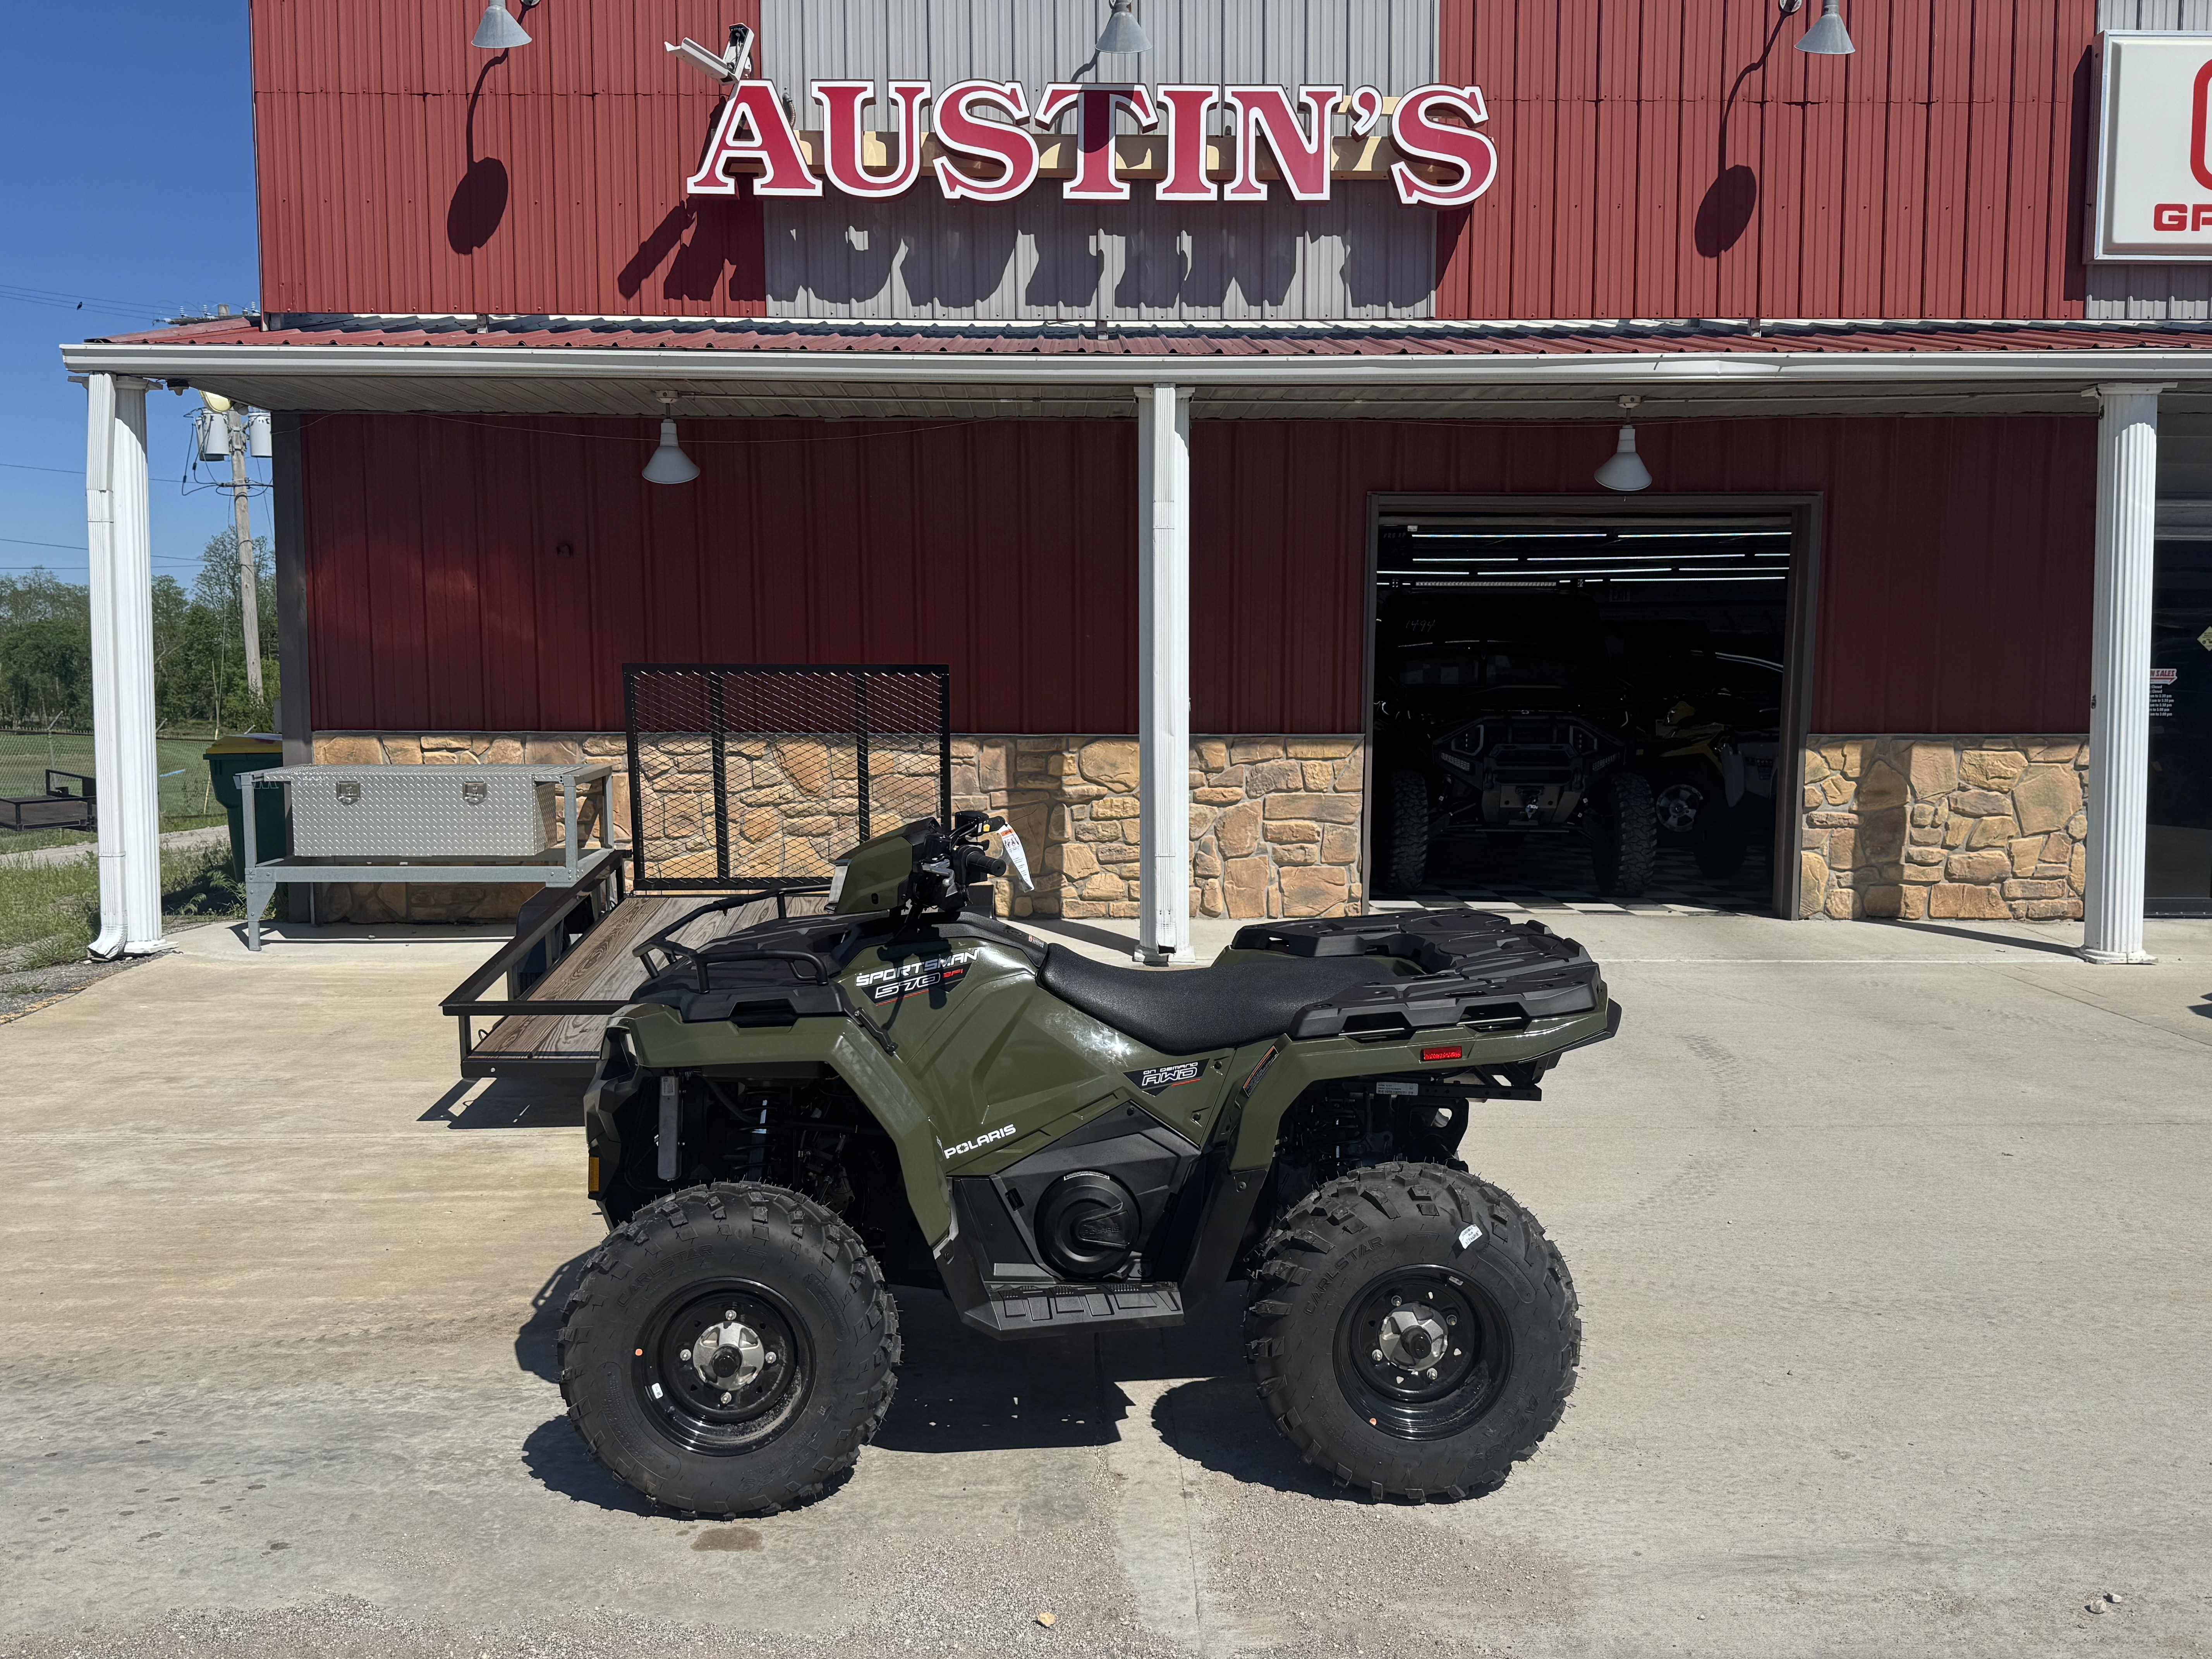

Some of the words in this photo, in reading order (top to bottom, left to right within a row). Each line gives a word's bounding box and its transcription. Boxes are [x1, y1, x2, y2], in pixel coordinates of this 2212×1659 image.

[687, 79, 1497, 206] AUSTIN'S
[1405, 619, 1436, 632] 1494
[855, 948, 979, 987] SPORTSMAN
[875, 972, 941, 999] 570
[1142, 1067, 1197, 1086] AWD
[1160, 1062, 1198, 1073] DEMAND
[944, 1124, 1016, 1159] POLARIS
[617, 1244, 714, 1307] CARLSTAR
[1304, 1236, 1384, 1316] CARLSTAR
